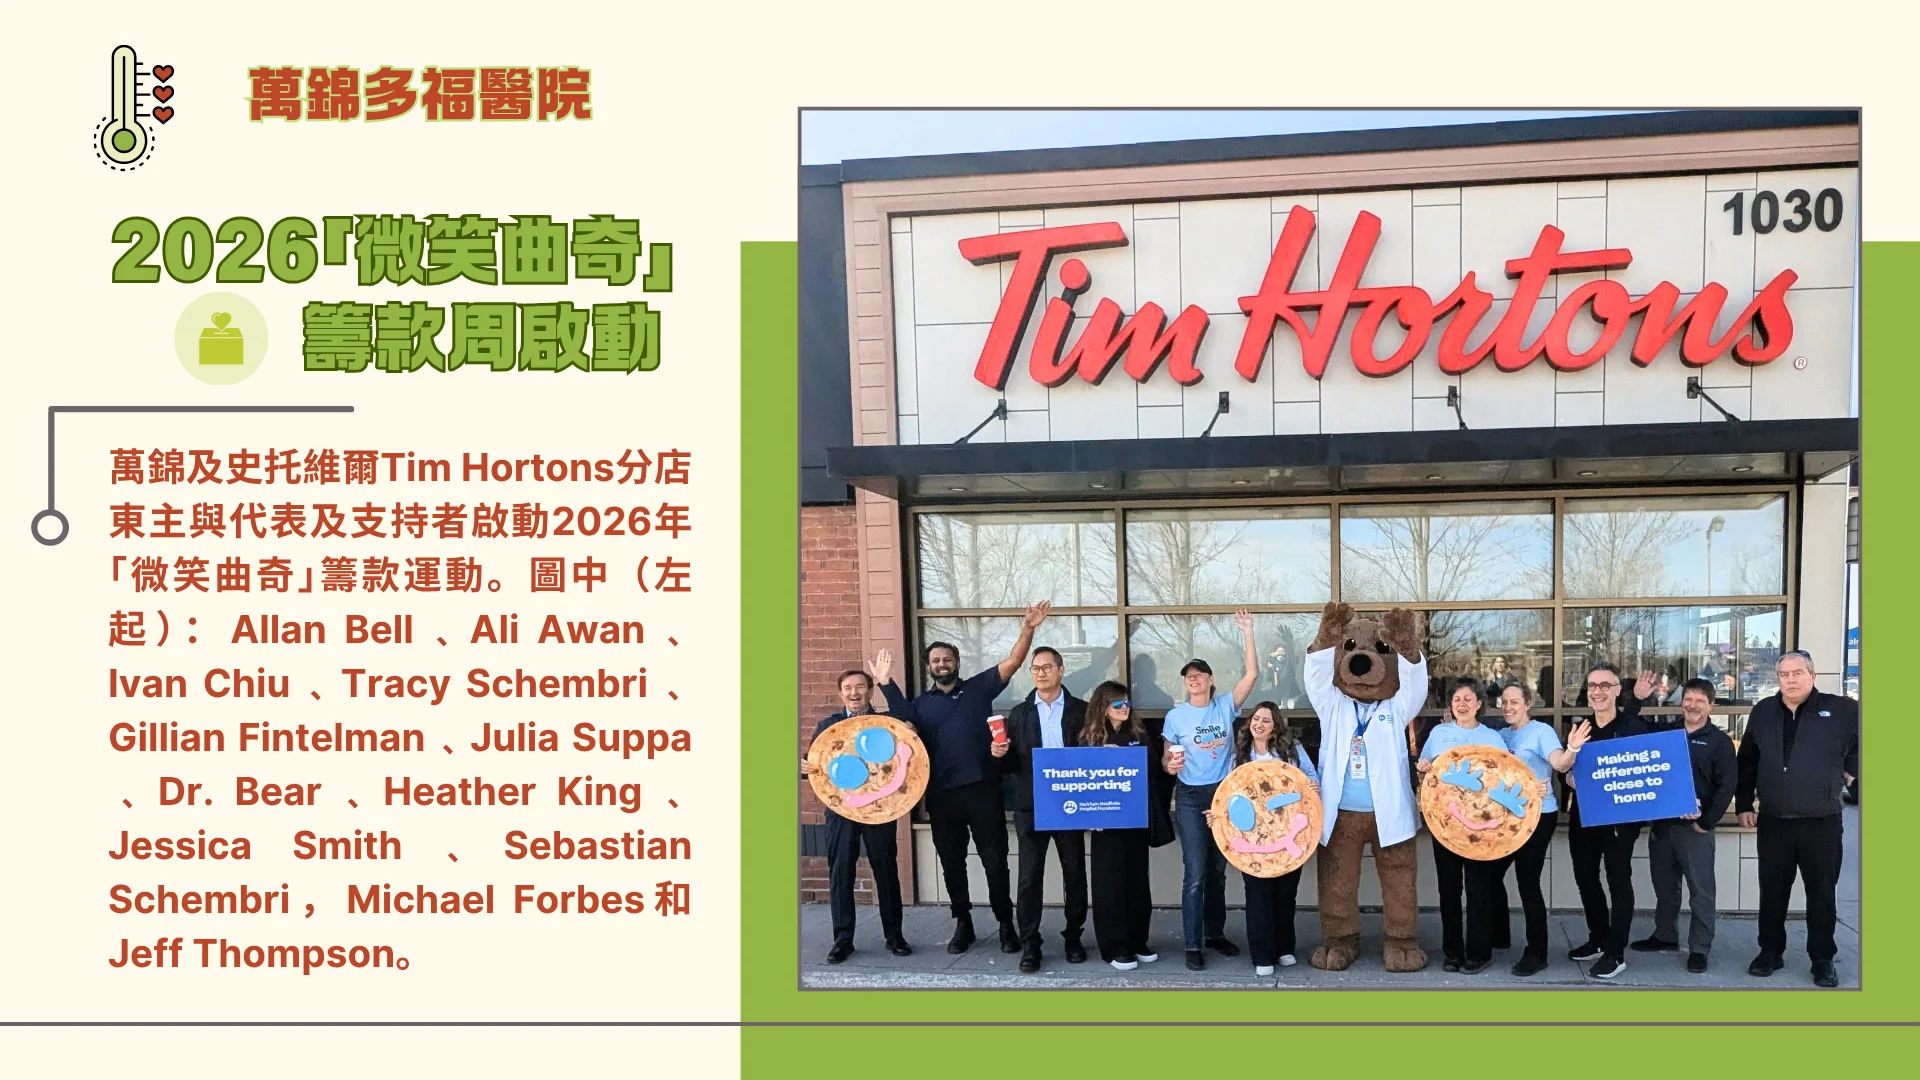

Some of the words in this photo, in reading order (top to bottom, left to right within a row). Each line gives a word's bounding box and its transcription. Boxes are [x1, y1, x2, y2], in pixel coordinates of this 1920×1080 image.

[1723, 187, 1843, 235] 1030
[958, 221, 1210, 391] Tim
[1234, 205, 1798, 382] Hortons
[1195, 725, 1220, 734] Smile
[1597, 750, 1649, 766] Making
[1650, 749, 1661, 759] a
[1042, 768, 1088, 779] Thank
[1089, 769, 1115, 780] you
[1117, 766, 1139, 777] for
[1591, 762, 1671, 780] difference
[1051, 780, 1132, 793] supporting
[1603, 779, 1644, 792] close
[1645, 776, 1663, 787] to
[1613, 791, 1656, 804] home
